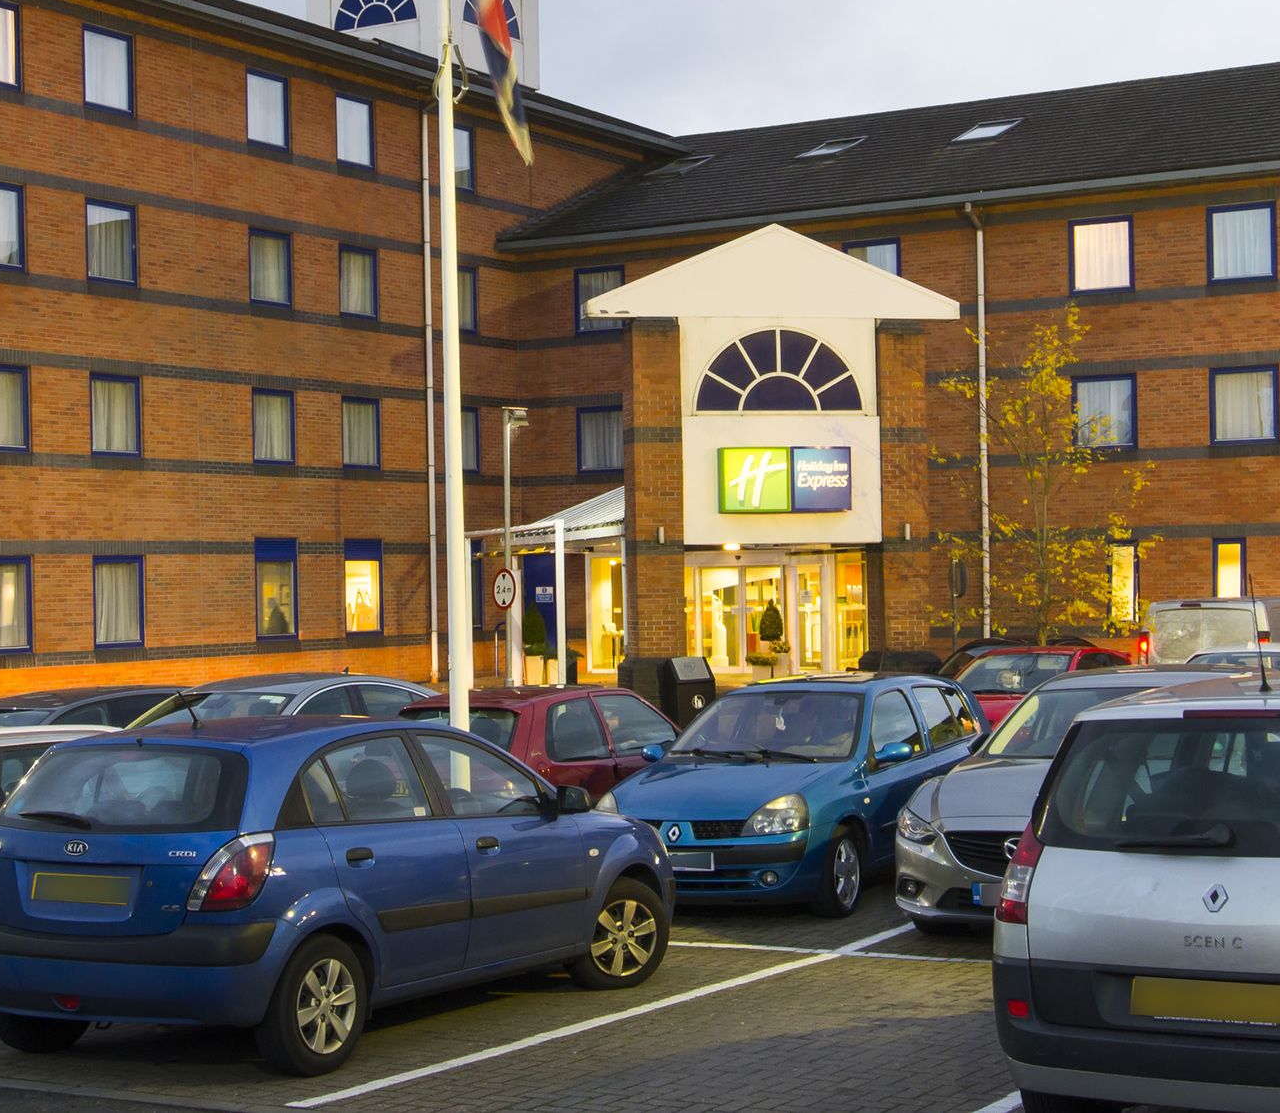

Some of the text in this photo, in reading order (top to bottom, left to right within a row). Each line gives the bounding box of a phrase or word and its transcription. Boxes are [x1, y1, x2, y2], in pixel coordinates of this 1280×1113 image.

[797, 460, 848, 474] Holiday Inn
[797, 472, 849, 491] Express
[66, 842, 86, 853] KIA
